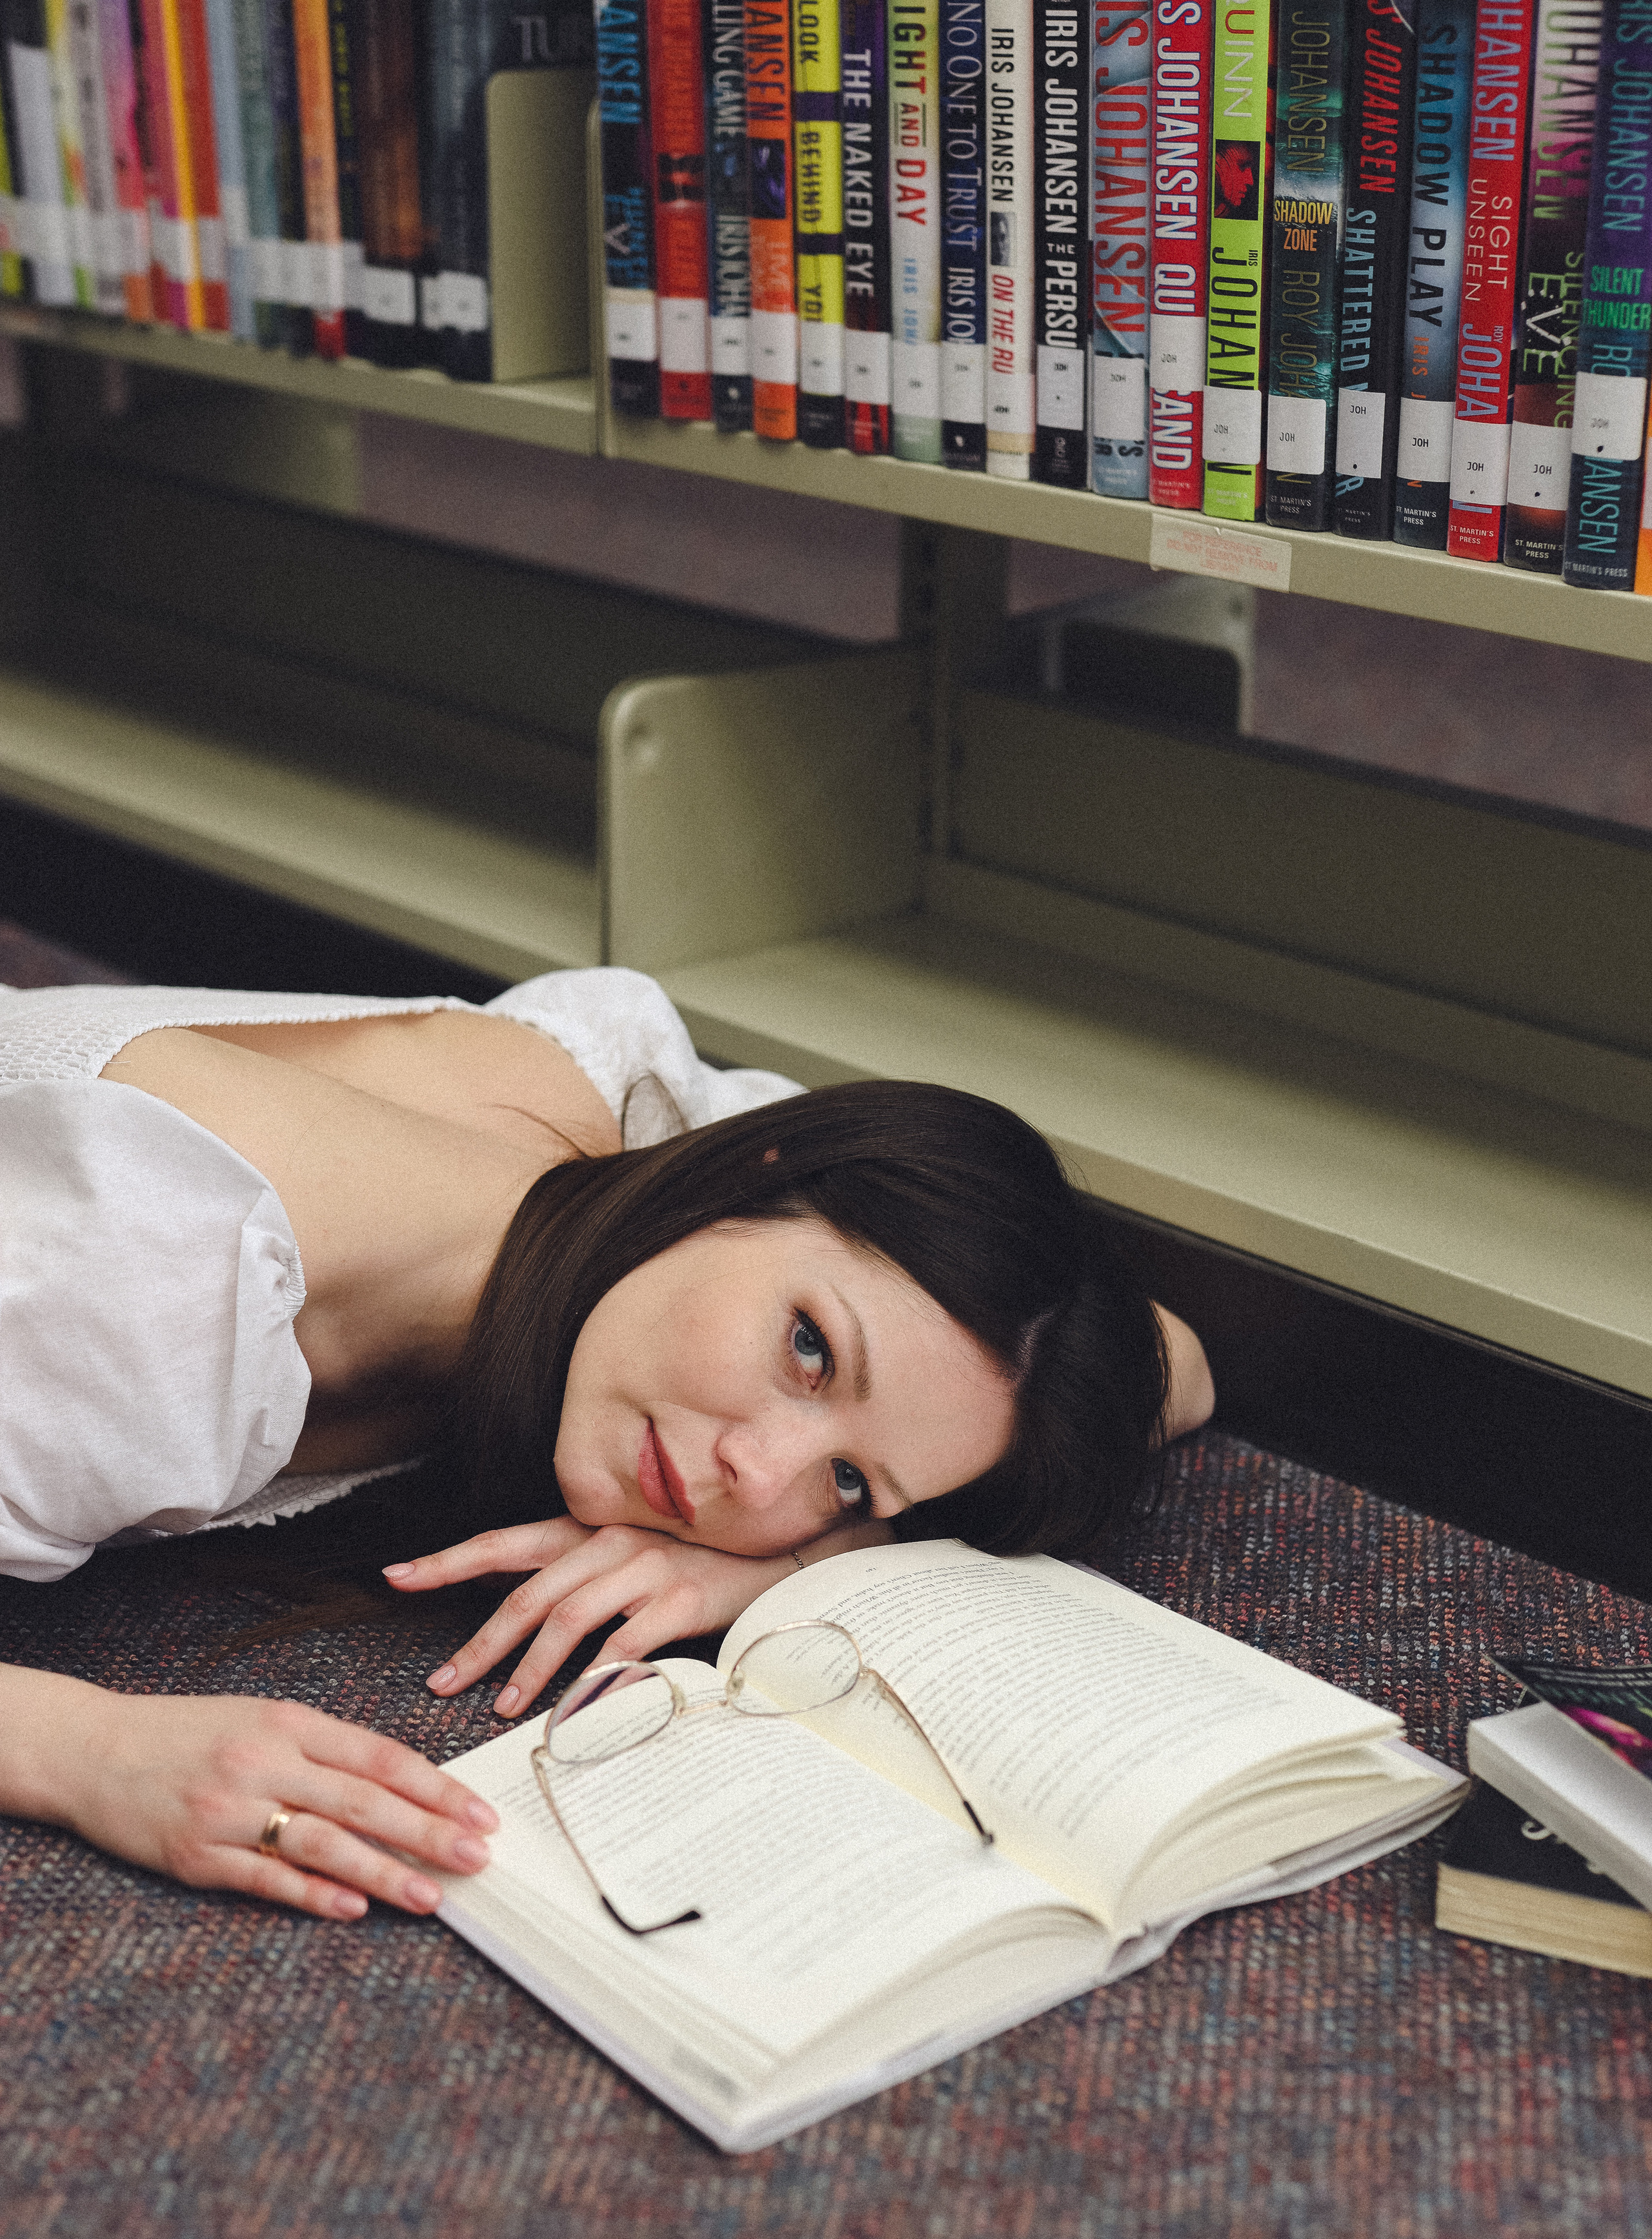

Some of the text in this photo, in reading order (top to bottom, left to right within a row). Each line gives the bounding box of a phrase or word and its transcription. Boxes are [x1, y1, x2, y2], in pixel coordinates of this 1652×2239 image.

[798, 1, 821, 64] LOOK
[1045, 9, 1078, 67] IRIS
[713, 0, 745, 136] LING GAME
[746, 0, 786, 121] ANSEN
[843, 49, 872, 107] THE
[1223, 0, 1256, 117] UINN
[1287, 12, 1330, 171] JOHANSEN
[1473, 0, 1524, 161] HANSEN
[893, 6, 928, 226] IGHT AND DAY
[945, 1, 983, 252] NO ONE TO TRUST
[991, 28, 1015, 202] IRIS JOHANSEN
[1360, 29, 1402, 192] JOHANSEN
[1045, 78, 1078, 233] JOHANSEN
[1154, 37, 1202, 240] JOHANSEN
[1603, 59, 1652, 231] JOHANSEN
[800, 131, 824, 222] BEHIND
[843, 123, 873, 227] NAKED
[1408, 25, 1458, 327] SHADOW PLAY
[1094, 66, 1149, 333] JOHANSEN
[1274, 199, 1334, 225] SHADOW
[1047, 243, 1075, 255] THE
[1247, 249, 1260, 267] IRIS
[1283, 227, 1318, 252] ZONE
[1465, 178, 1488, 302] UNSEEN
[1488, 196, 1513, 289] SIGHT
[845, 243, 875, 298] EYE
[947, 267, 977, 307] IRIS
[992, 274, 1014, 303] ON
[1340, 207, 1376, 372] SHATTERED
[1590, 265, 1644, 296] SILENT
[1282, 270, 1320, 326] ROY
[1582, 299, 1651, 331] THUNDER
[992, 309, 1014, 343] THE
[1493, 325, 1505, 344] ROY
[1523, 273, 1568, 375] EVE
[1412, 336, 1430, 376] IRIS
[1350, 405, 1366, 415] JOH
[1280, 432, 1295, 443] JOH
[1412, 437, 1429, 448] JOH
[1467, 461, 1484, 472] JOH
[1533, 463, 1553, 475] JOH
[1280, 496, 1311, 507] MARTIN'S
[1280, 505, 1300, 514] PRESS
[1404, 507, 1437, 518] MARTIN'S
[1404, 516, 1424, 525] PRESS
[1183, 530, 1262, 557] FOR REFERENCE
[1450, 525, 1495, 538] ST. MARTIN'S
[1459, 536, 1481, 545] PRESS
[1526, 541, 1564, 551] MARTIN'S
[1167, 538, 1182, 551] DO
[1182, 543, 1203, 554] NOT
[1248, 556, 1278, 572] FROM
[1526, 550, 1549, 559] PRESS
[1604, 567, 1628, 578] PRESS
